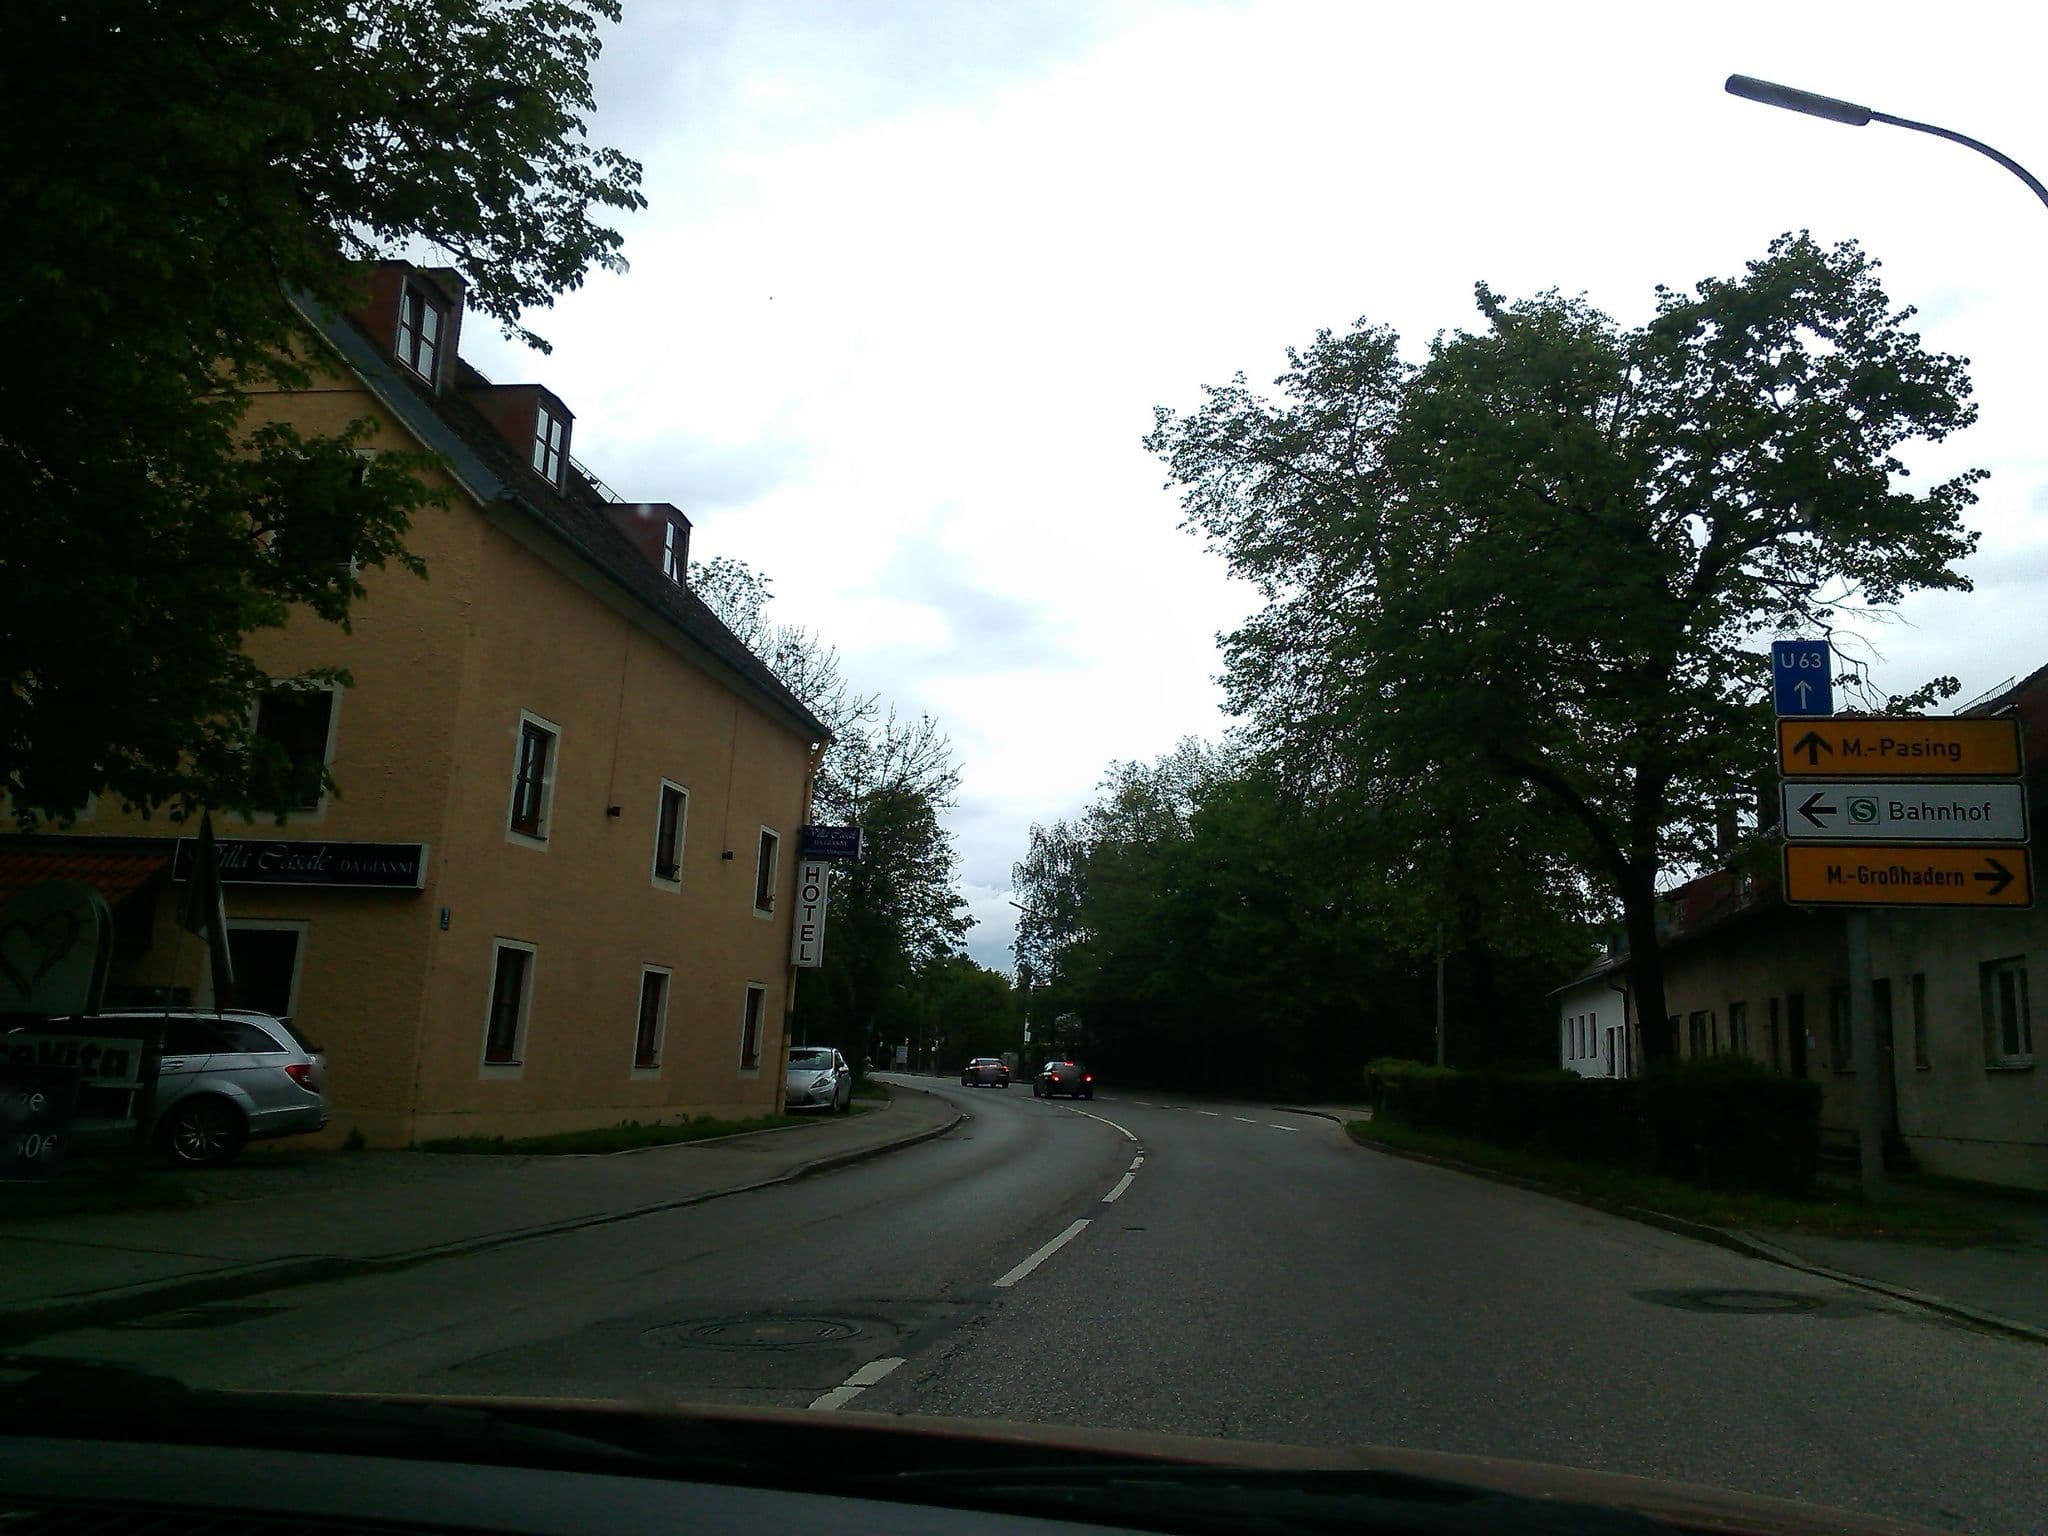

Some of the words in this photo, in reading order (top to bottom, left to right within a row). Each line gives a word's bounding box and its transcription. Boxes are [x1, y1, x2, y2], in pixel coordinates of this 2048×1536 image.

[1842, 738, 1961, 761] M.-Pasing
[1889, 801, 1991, 821] Bahnhof
[1827, 865, 1964, 887] M.-Großhadern
[800, 867, 820, 961] HOTEL
